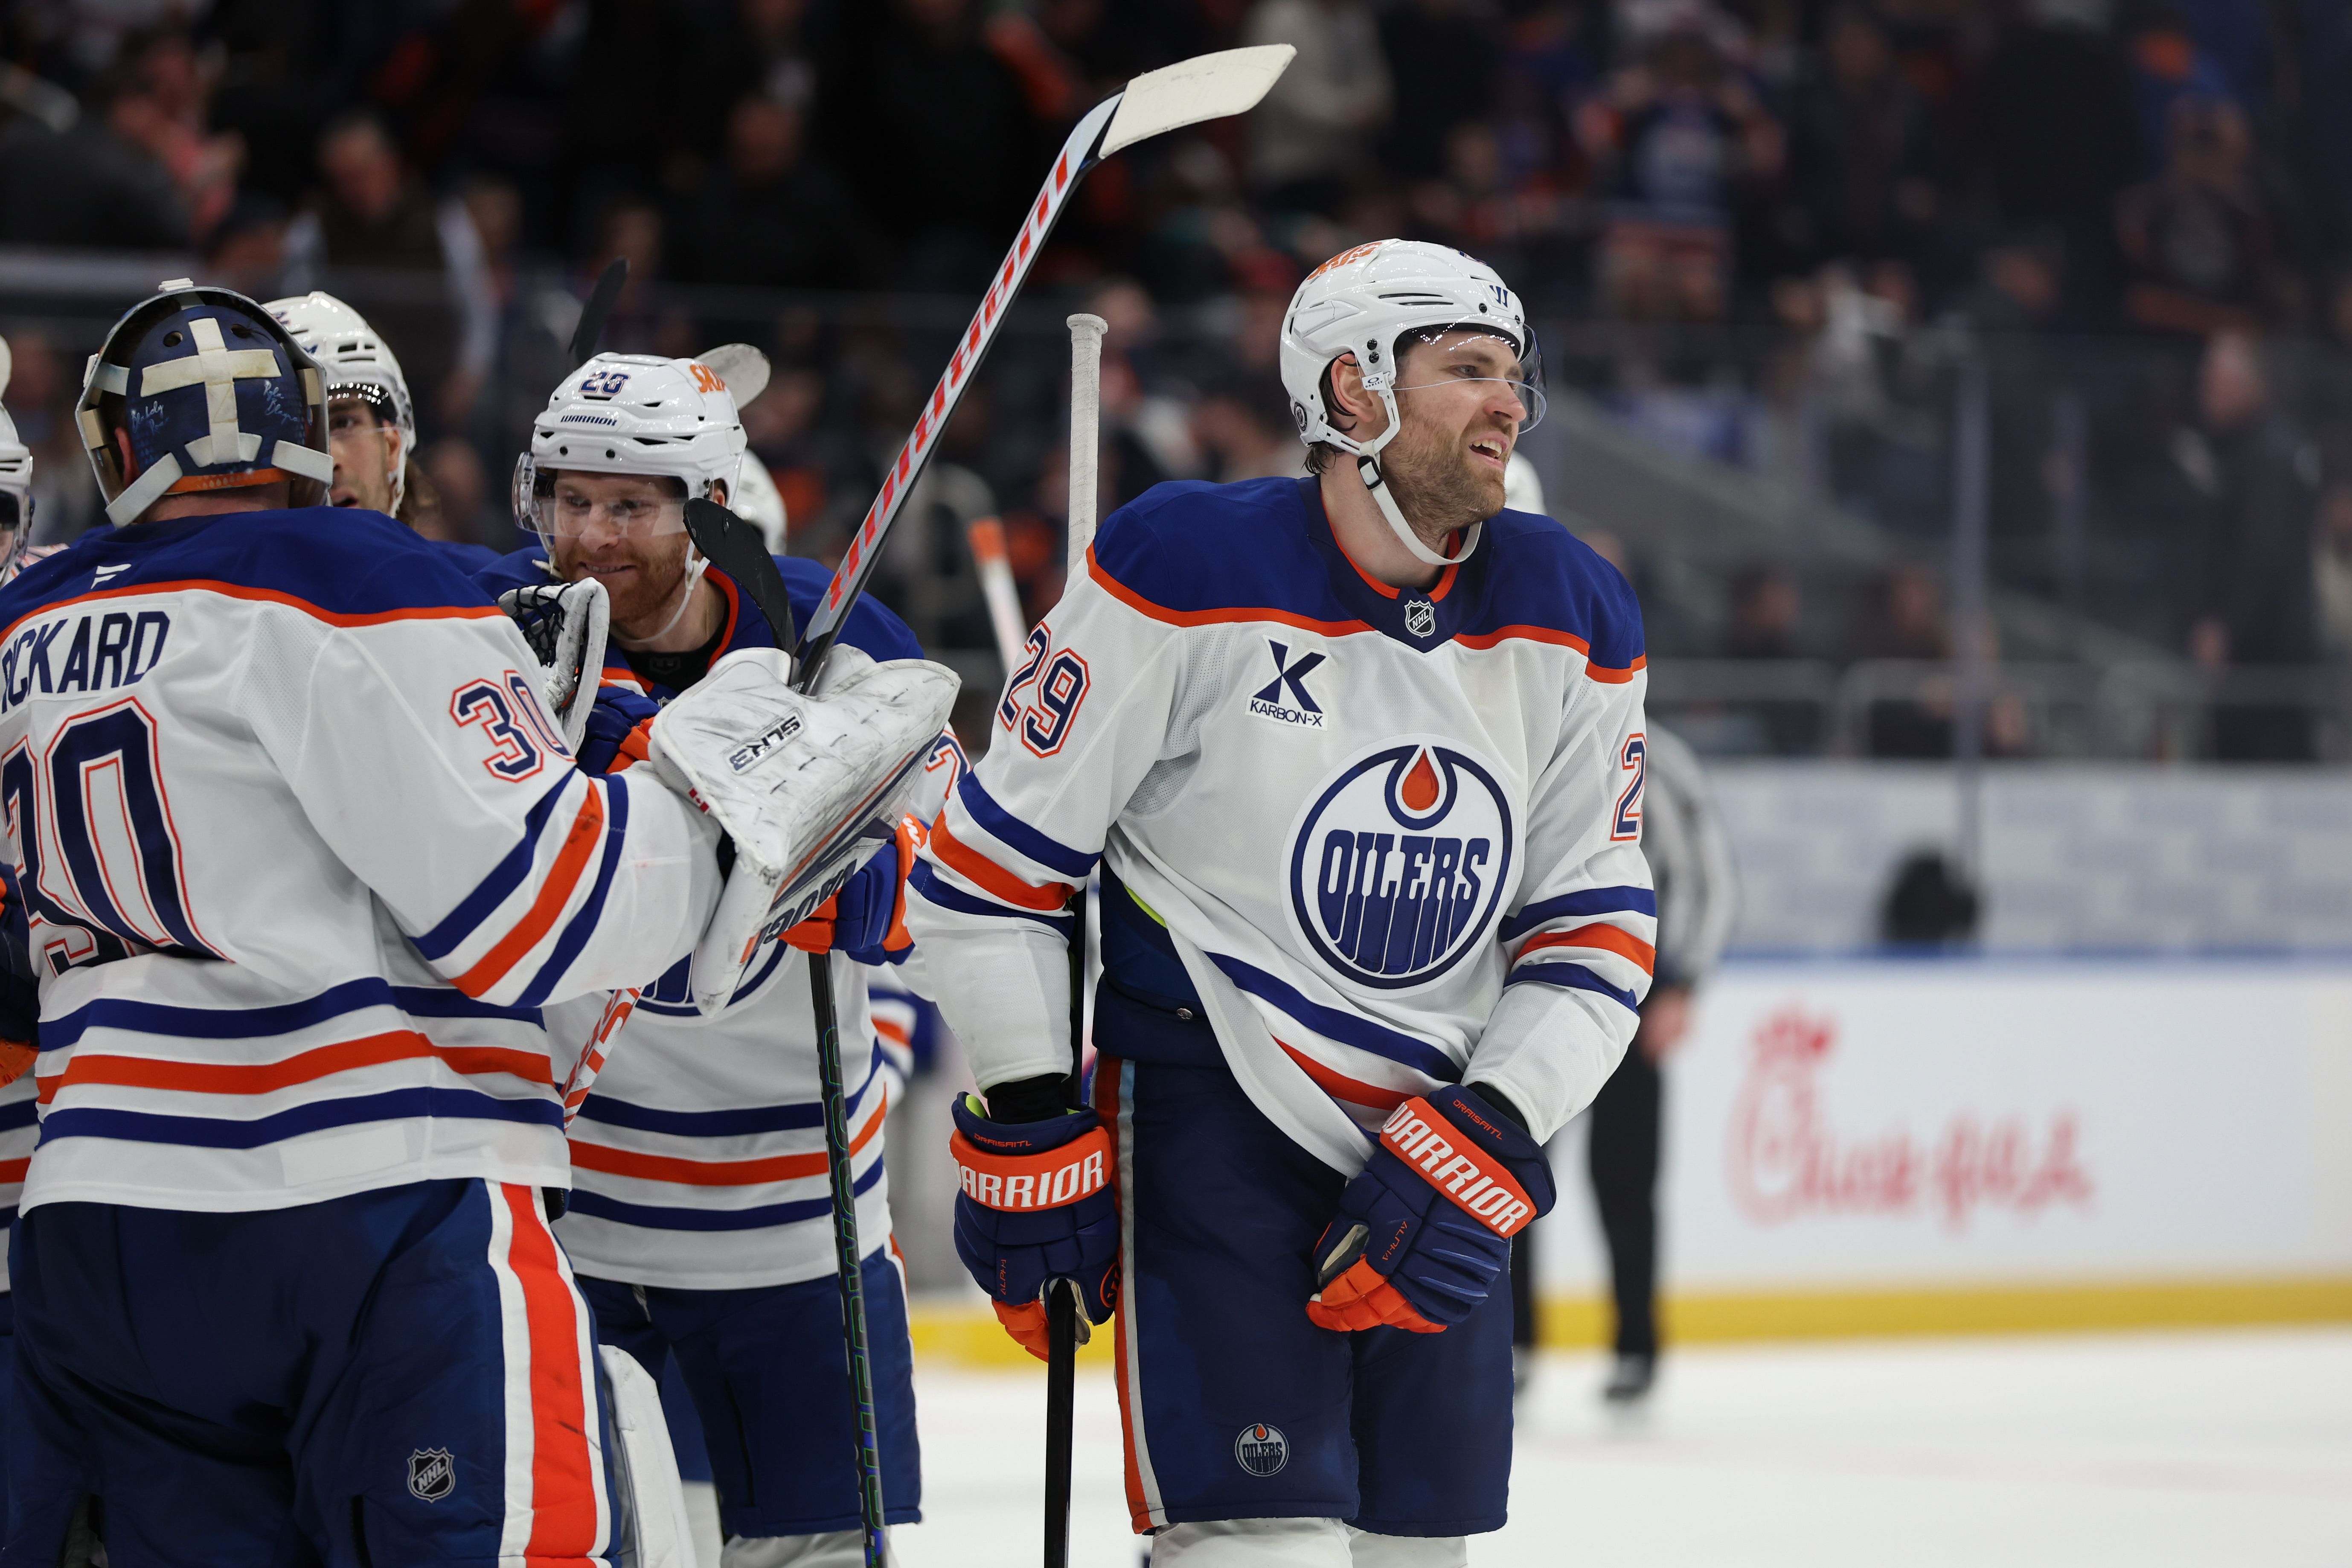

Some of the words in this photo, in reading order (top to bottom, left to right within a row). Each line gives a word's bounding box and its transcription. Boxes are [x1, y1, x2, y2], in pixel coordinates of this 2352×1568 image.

[689, 364, 725, 393] SKI
[560, 415, 617, 426] WARRIOR
[1412, 611, 1429, 629] NHL
[998, 620, 1091, 759] 29
[449, 669, 577, 783] 30
[1250, 699, 1323, 727] KARBON-X
[1610, 733, 1647, 841] 2
[1, 696, 235, 978] 30
[1317, 829, 1491, 975] OILERS
[1453, 1099, 1502, 1140] DRAISAITL
[974, 1133, 1032, 1148] DRAISAITL
[1382, 1101, 1529, 1233] WARRIOR
[1242, 1442, 1283, 1473] OILERS
[417, 1461, 445, 1491] NHL
